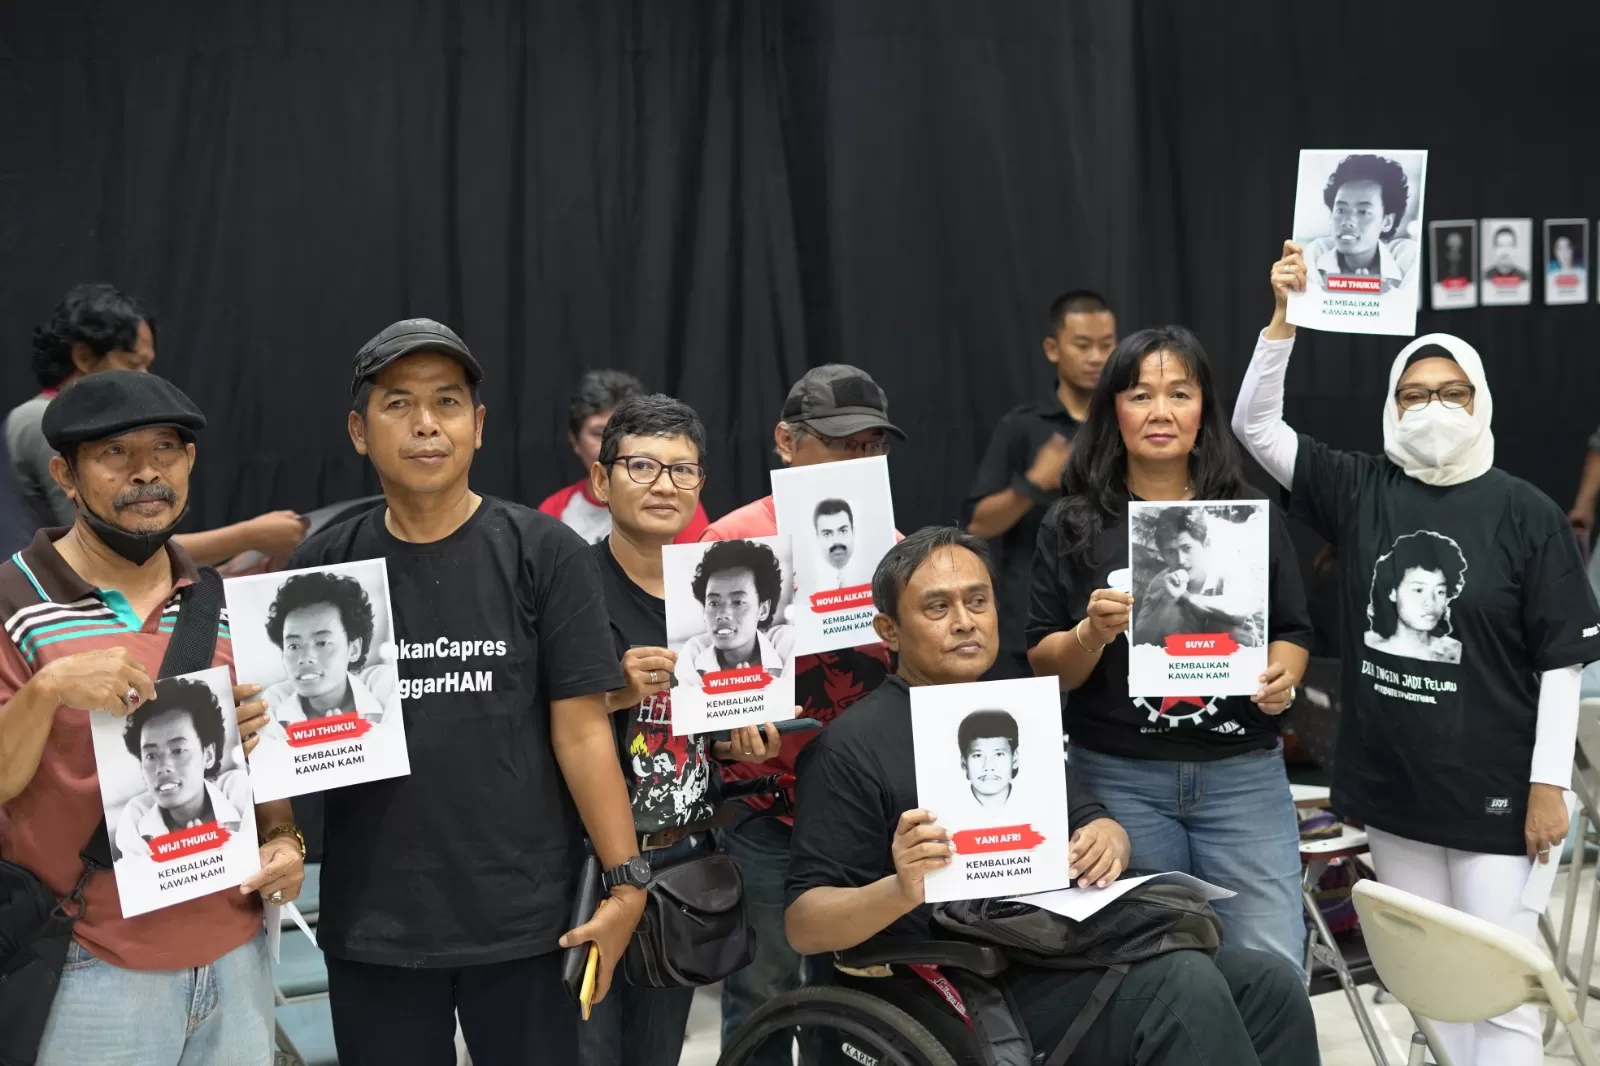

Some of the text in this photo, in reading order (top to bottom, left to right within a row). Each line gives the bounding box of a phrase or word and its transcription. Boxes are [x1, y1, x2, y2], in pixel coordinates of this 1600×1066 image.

[1328, 280, 1380, 289] WIJI THUKUL
[816, 595, 843, 606] NOVAL
[822, 611, 873, 625] KEMBALIKAN
[823, 620, 873, 635] KAWAN KAM
[1185, 640, 1216, 649] SUYAT
[1169, 662, 1230, 670] KEMBALIKAN
[709, 674, 763, 688] WIJI THUKUL
[1361, 660, 1457, 692] DIA INGIN JADI PELURU
[706, 694, 764, 709] KEMBALIKAN
[706, 704, 765, 719] KAWAN KAMI
[292, 721, 357, 740] WIJI THUKUL
[294, 744, 363, 763] KEMBALIKAN
[295, 755, 365, 775] KAWAN KAMI
[157, 831, 219, 854] WIJI THUKUL
[975, 832, 1021, 845] YANI AFRI
[158, 854, 224, 879] KEMBALIKAN
[966, 856, 1031, 869] KEMBALIKAN
[159, 866, 226, 891] KAWAN KAMI
[966, 867, 1032, 880] KAWAN KAMI
